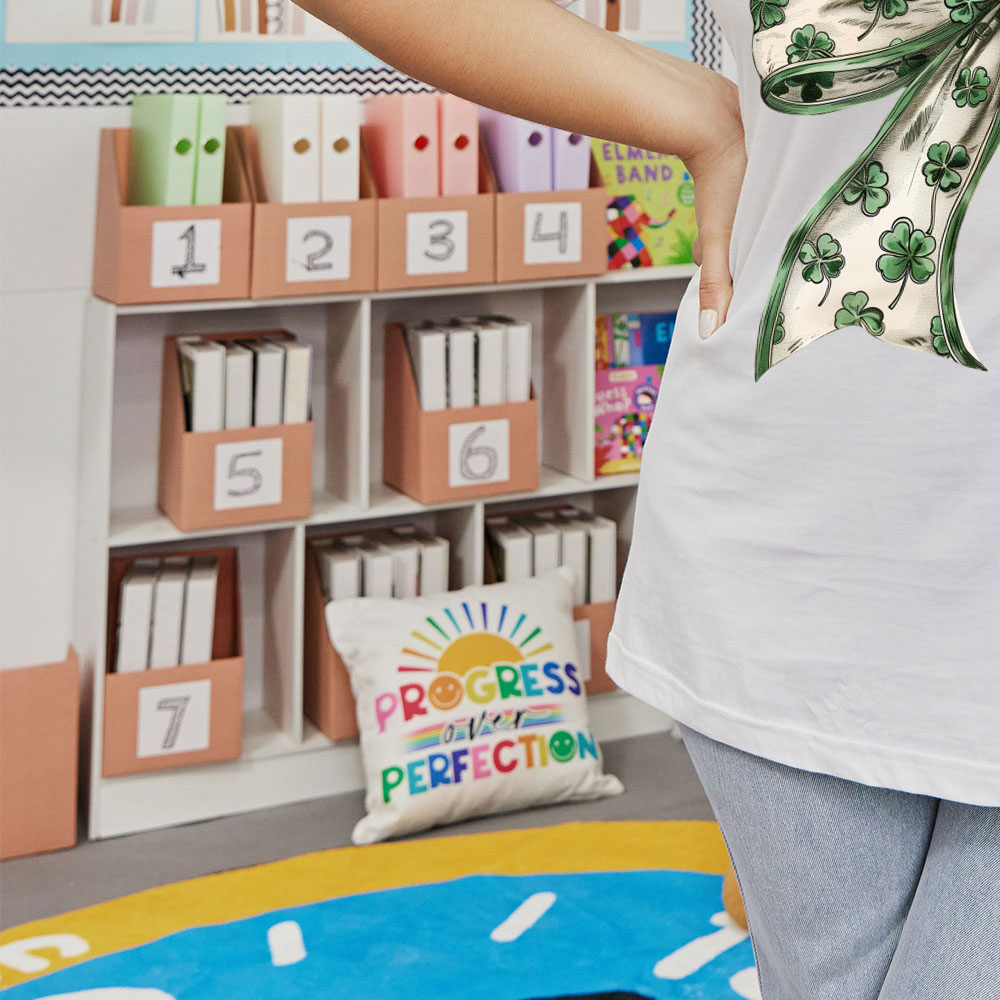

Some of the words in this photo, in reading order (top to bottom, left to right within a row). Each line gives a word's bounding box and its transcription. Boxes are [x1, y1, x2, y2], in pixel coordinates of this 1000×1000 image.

[616, 164, 674, 184] BAND
[171, 224, 207, 281] 1
[298, 229, 335, 273] 2
[424, 219, 456, 263] 3
[530, 210, 569, 255] 4
[226, 450, 265, 498] 5
[458, 425, 500, 483] 6
[375, 662, 581, 734] PROGRESS
[156, 694, 192, 751] 7
[441, 708, 528, 744] over
[381, 730, 599, 804] PERFECTION
